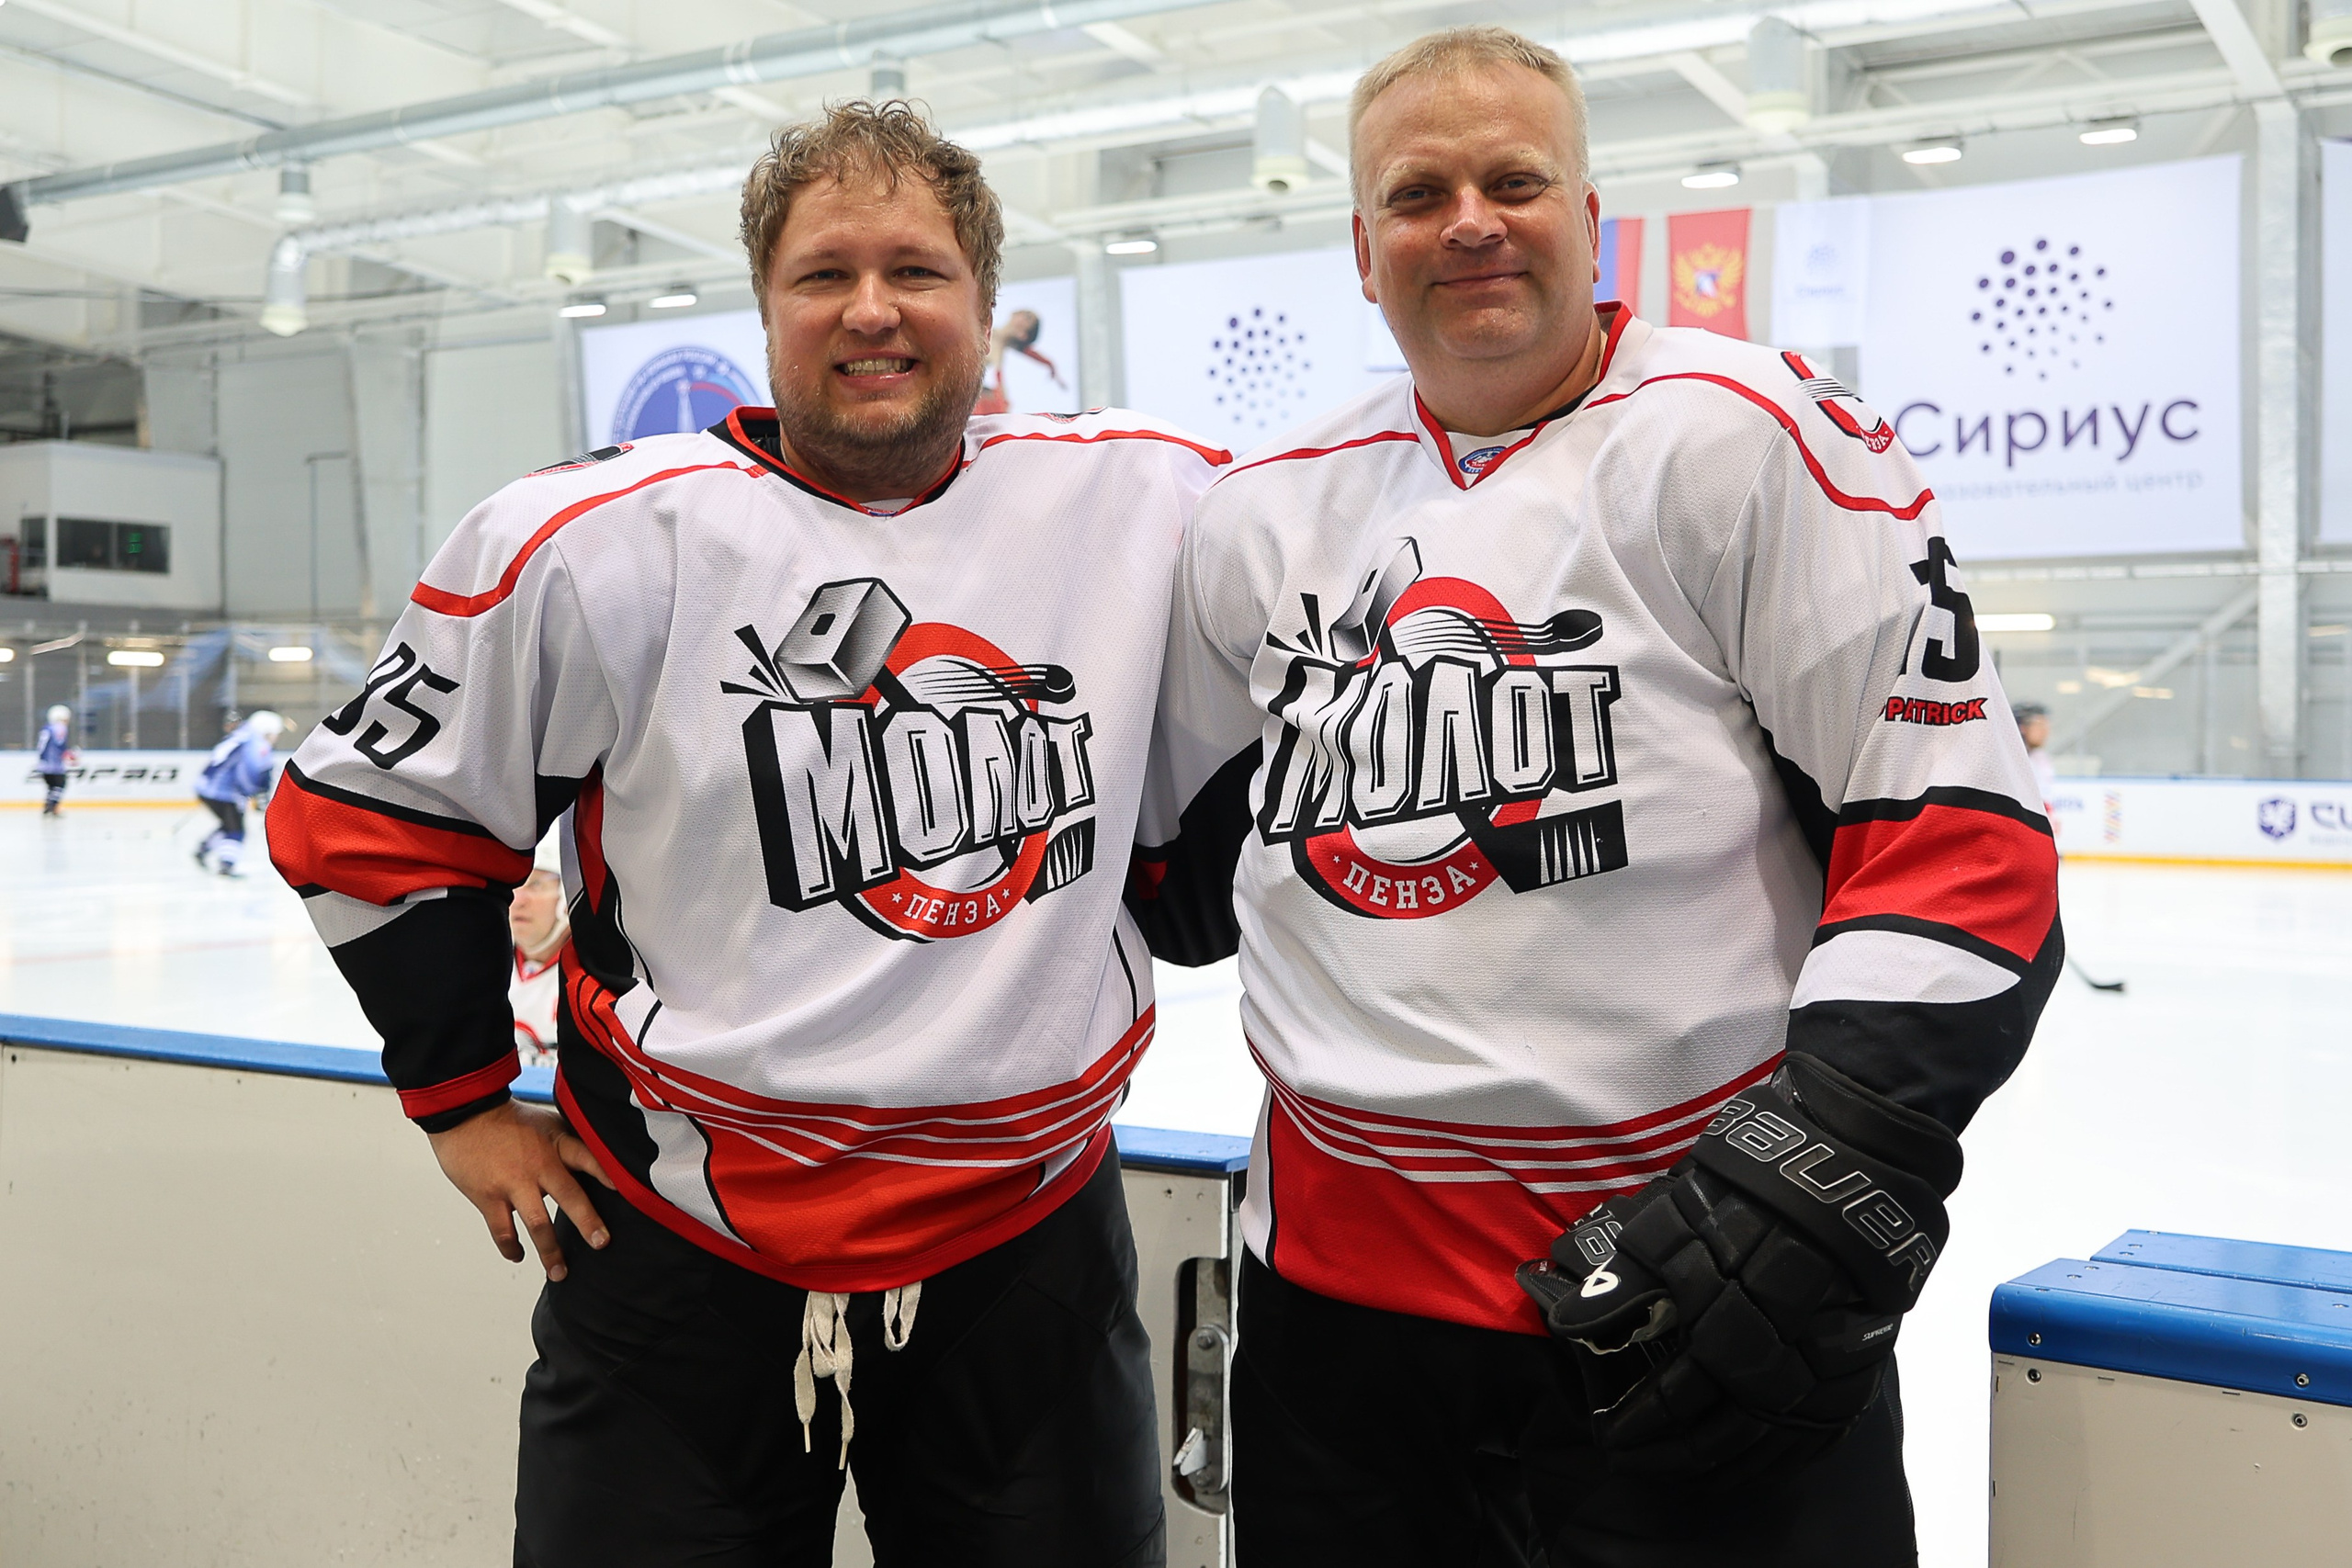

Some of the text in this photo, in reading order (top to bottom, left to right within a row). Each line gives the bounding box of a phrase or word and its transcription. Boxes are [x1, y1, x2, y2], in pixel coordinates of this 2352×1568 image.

[1895, 400, 2199, 468] Сириус
[1884, 695, 1988, 726] PATRICK
[1254, 655, 1622, 847] МОЛОТ
[742, 700, 1095, 913] МОЛОТ
[904, 892, 1002, 927] ПЕНЗА
[1342, 863, 1476, 909] ПЕНЗА
